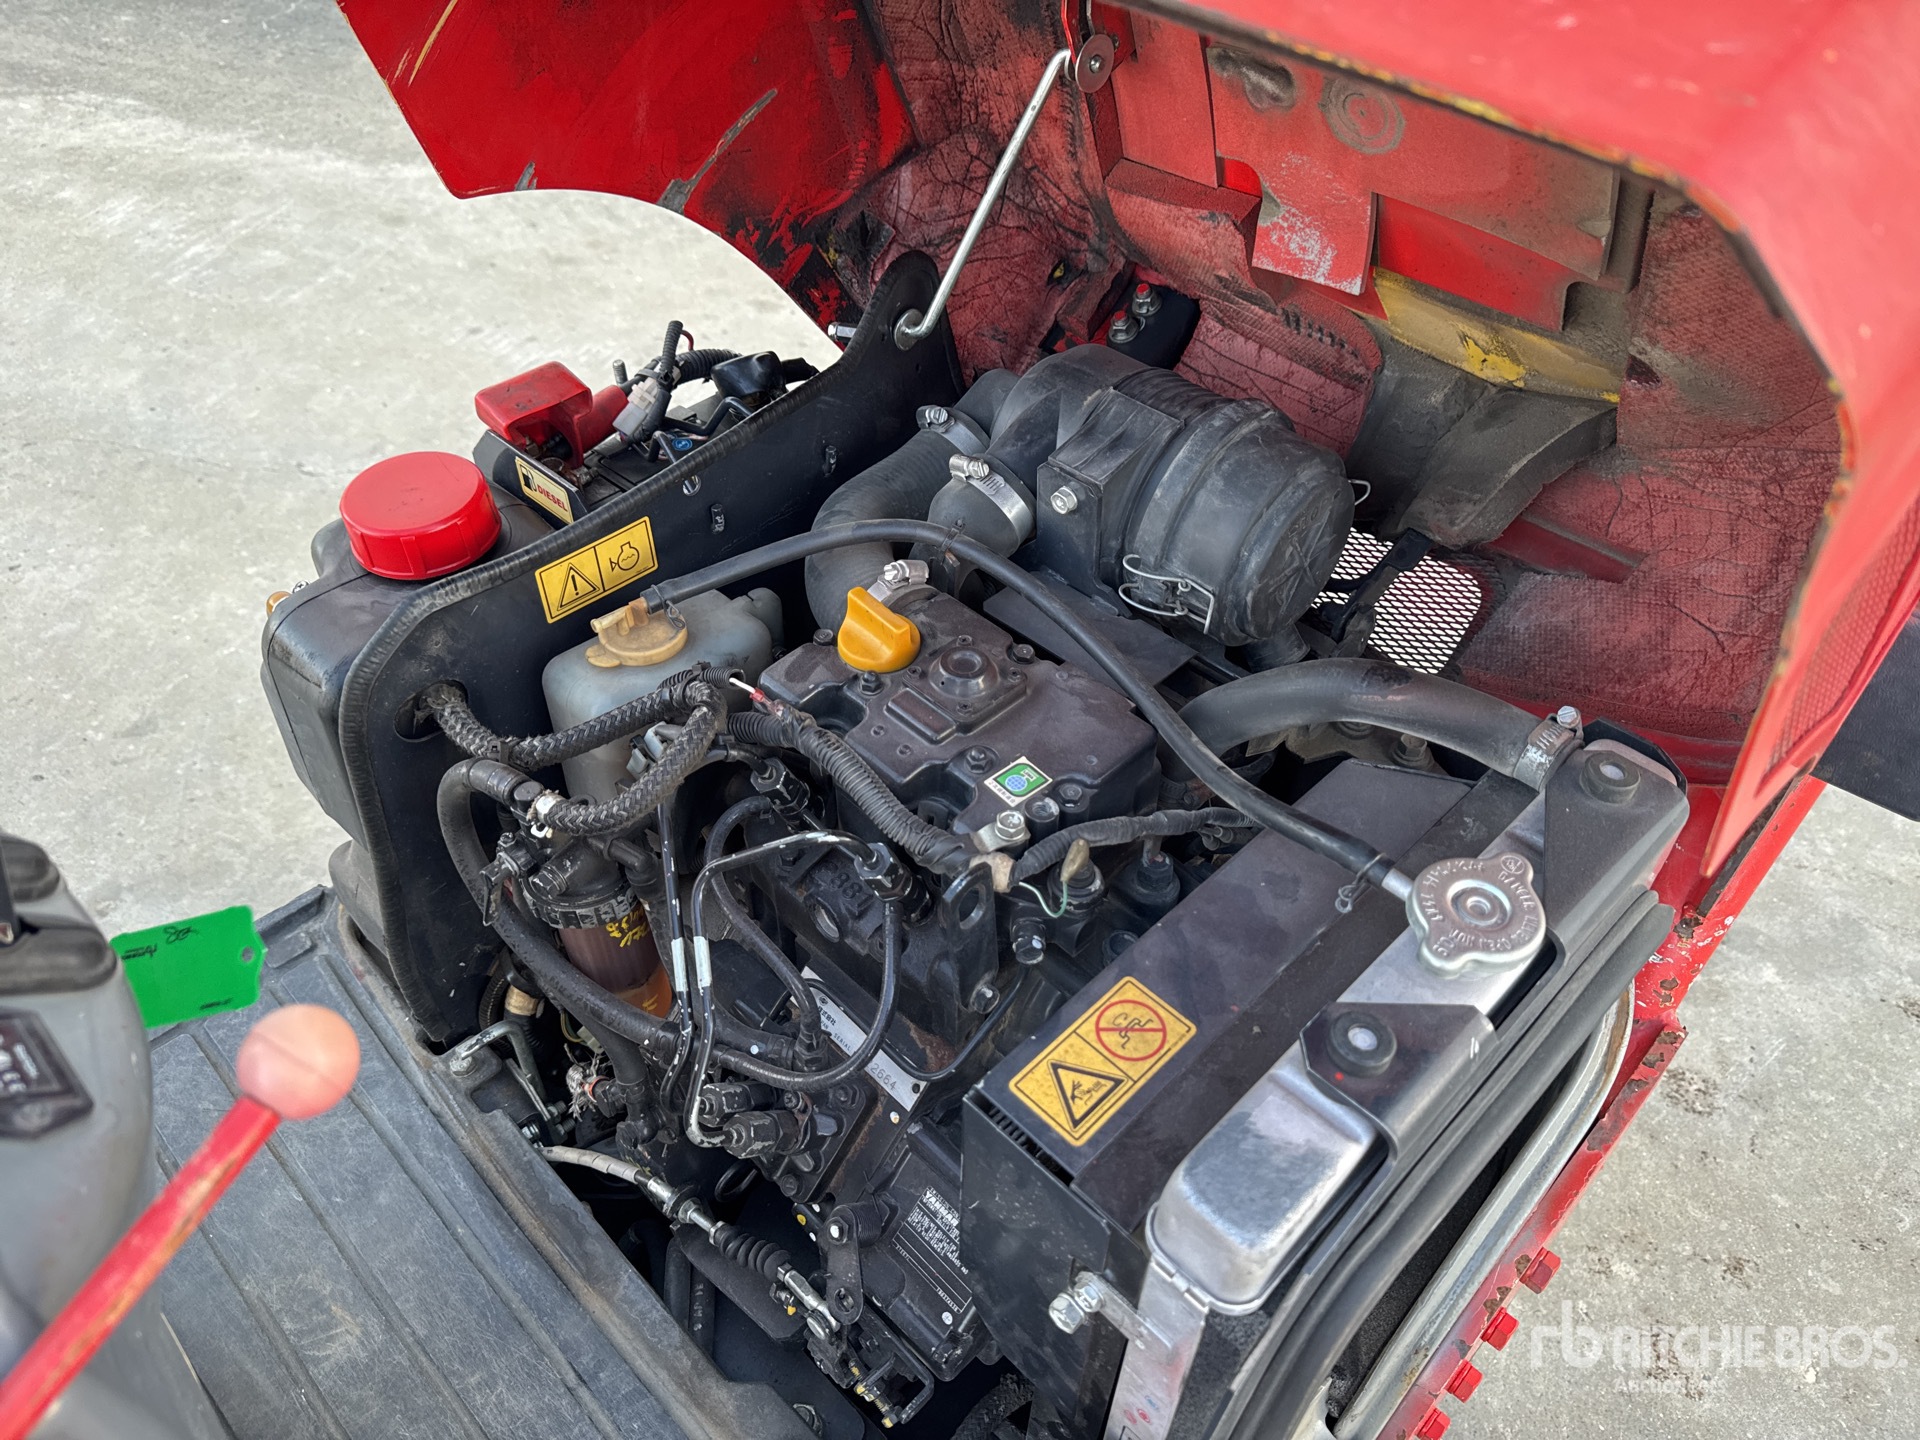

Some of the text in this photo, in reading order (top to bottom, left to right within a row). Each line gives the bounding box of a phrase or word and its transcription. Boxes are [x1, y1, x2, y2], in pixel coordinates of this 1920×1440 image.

[537, 485, 568, 512] DIESEL
[866, 1060, 899, 1092] 2664
[925, 1190, 959, 1227] YANMAR
